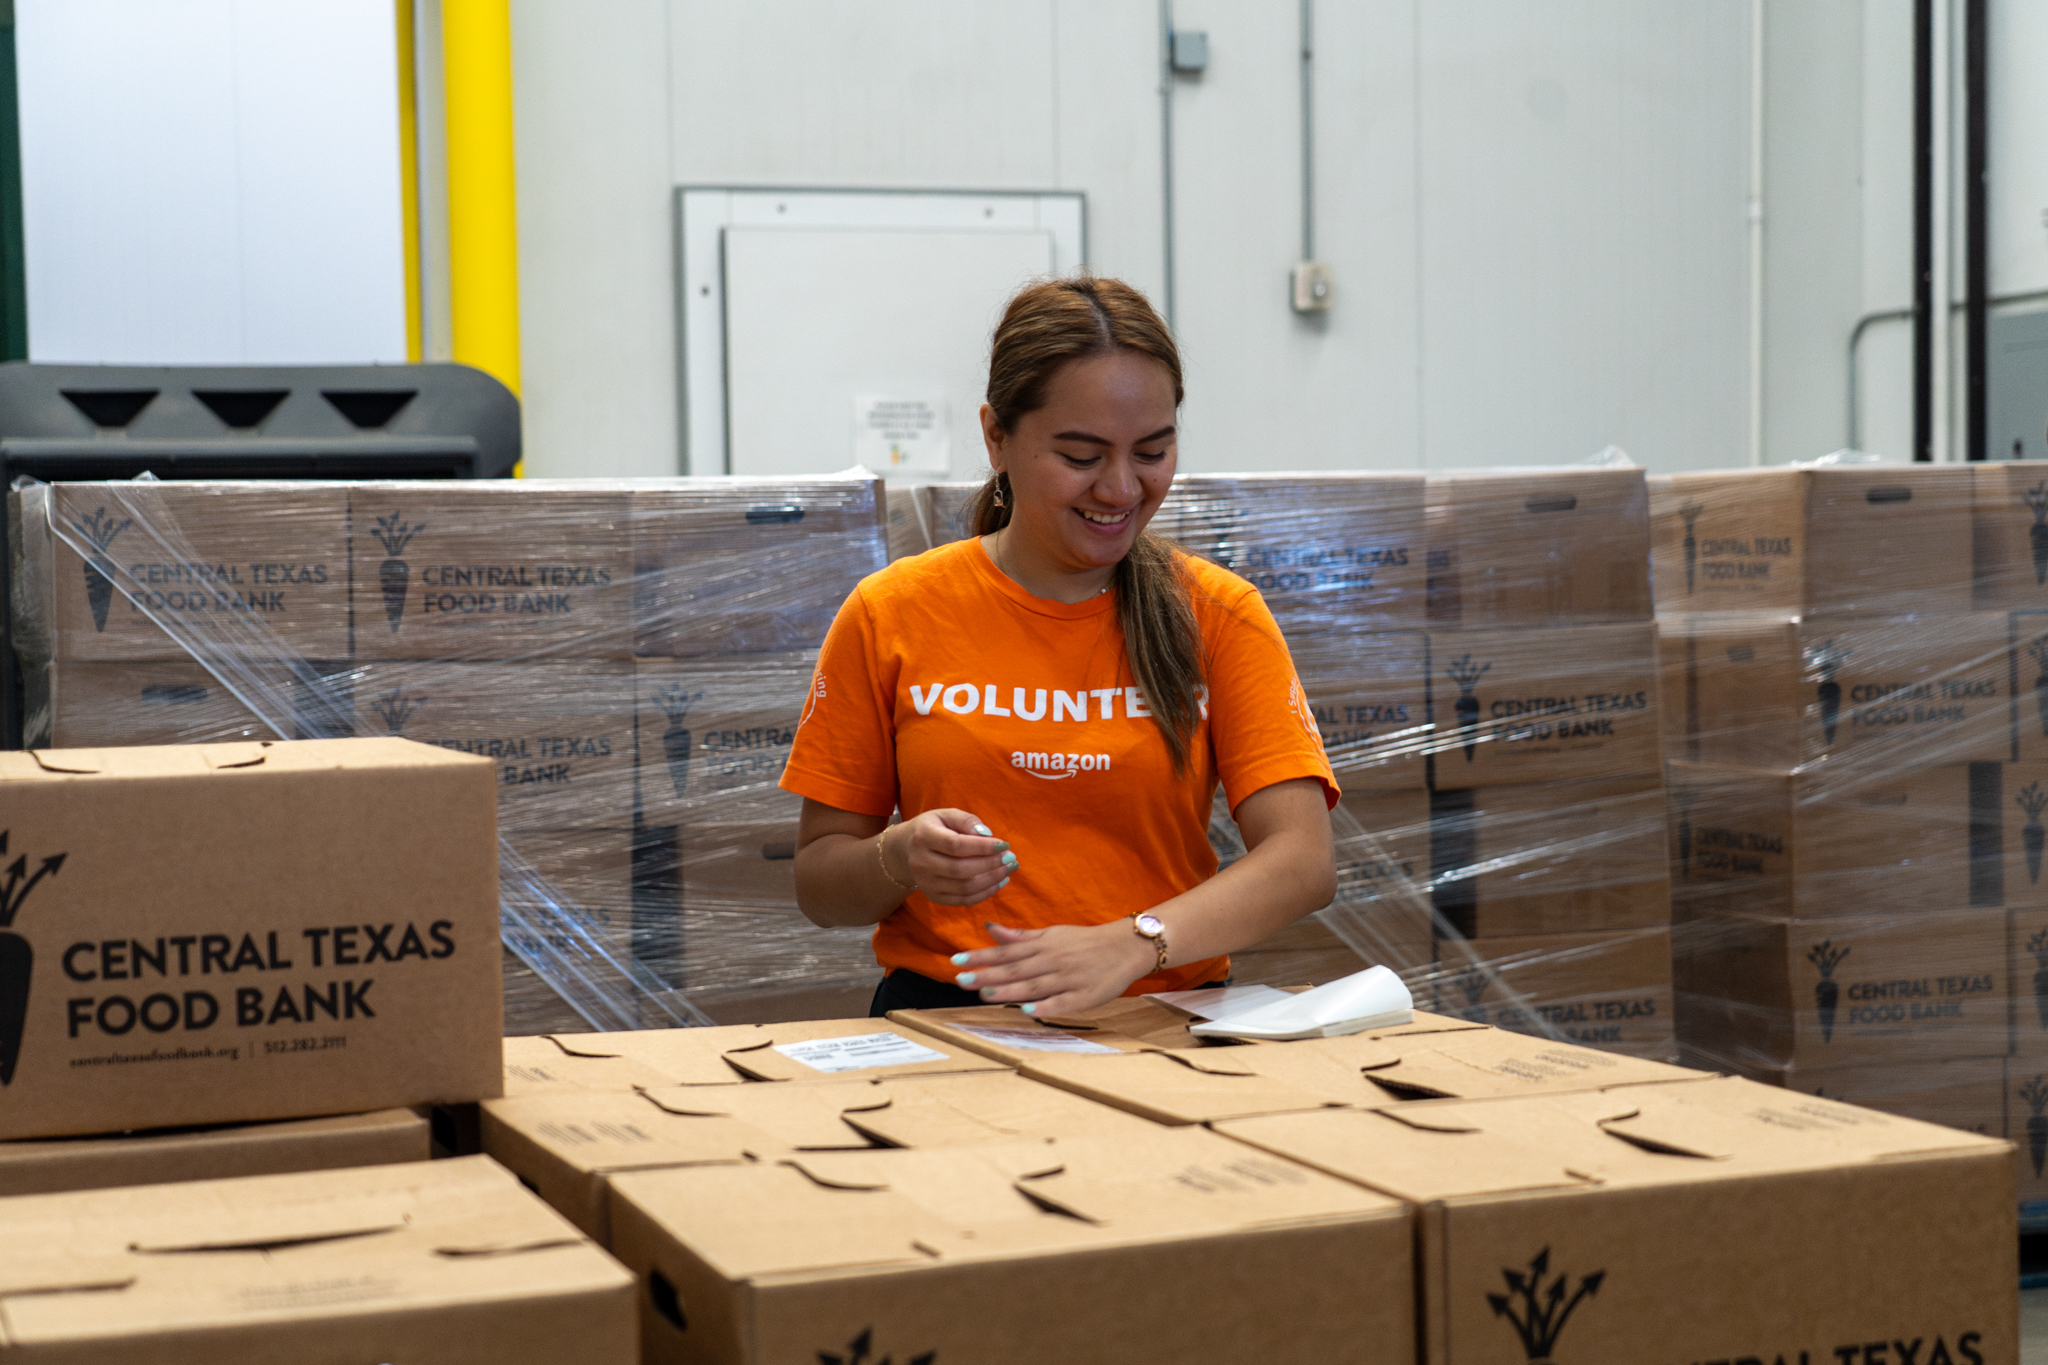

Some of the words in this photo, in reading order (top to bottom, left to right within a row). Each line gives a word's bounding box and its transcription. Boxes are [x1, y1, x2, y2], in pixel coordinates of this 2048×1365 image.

[129, 563, 244, 584] CENTRAL
[250, 563, 328, 584] TEXAS
[422, 566, 532, 587] CENTRAL
[537, 566, 612, 587] TEXAS
[130, 591, 206, 613] FOOD
[215, 591, 286, 612] BANK
[424, 593, 497, 614] FOOD
[504, 593, 571, 613] BANK
[909, 683, 1210, 722] VOLUNTER
[1585, 692, 1647, 713] TEXAS
[1345, 706, 1408, 723] TEXAS
[704, 727, 796, 748] CENTRA
[1558, 719, 1614, 739] BANK
[537, 737, 612, 757] TEXAS
[1011, 751, 1110, 771] amazon
[504, 763, 571, 784] BANK
[62, 931, 292, 982] CENTRAL
[303, 920, 456, 967] TEXAS
[1848, 979, 1931, 1001] CENTRAL
[1937, 974, 1992, 995] TEXAS
[68, 991, 219, 1038] FOOD
[236, 979, 376, 1027] BANK
[1594, 998, 1654, 1020] TEXAS
